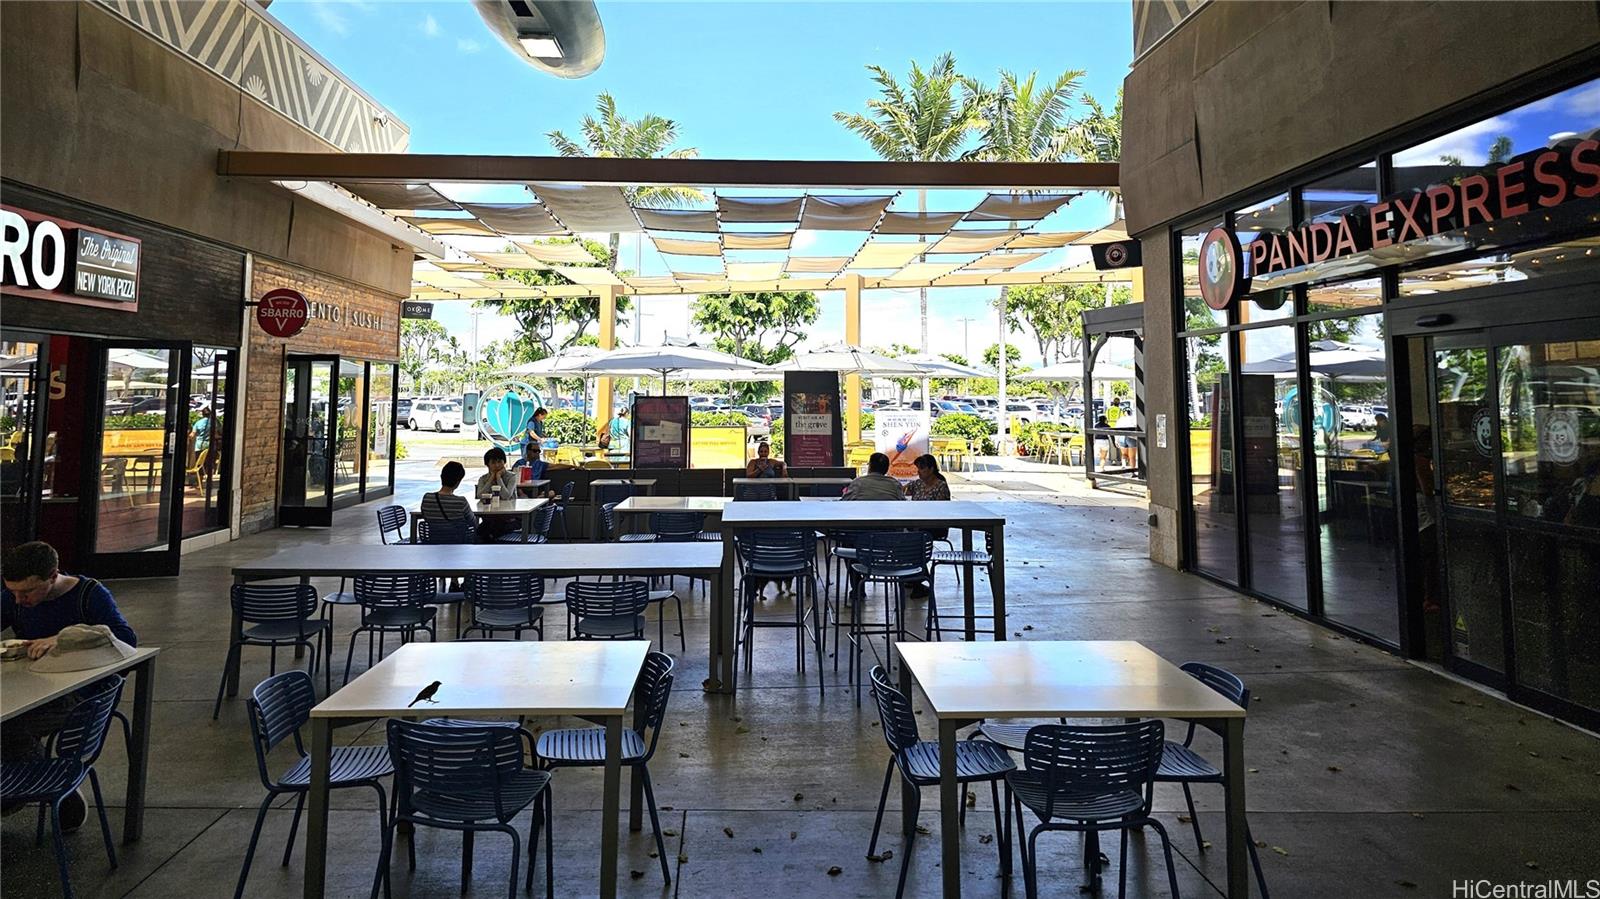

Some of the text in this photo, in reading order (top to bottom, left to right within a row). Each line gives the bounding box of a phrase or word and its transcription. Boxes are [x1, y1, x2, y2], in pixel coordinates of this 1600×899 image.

[1251, 139, 1600, 277] PANDA EXPRESS
[80, 236, 136, 267] The Original
[77, 271, 136, 299] NEW YORK PIZZA
[260, 307, 304, 319] SBARRO
[306, 301, 384, 331] ENTO SUSHI
